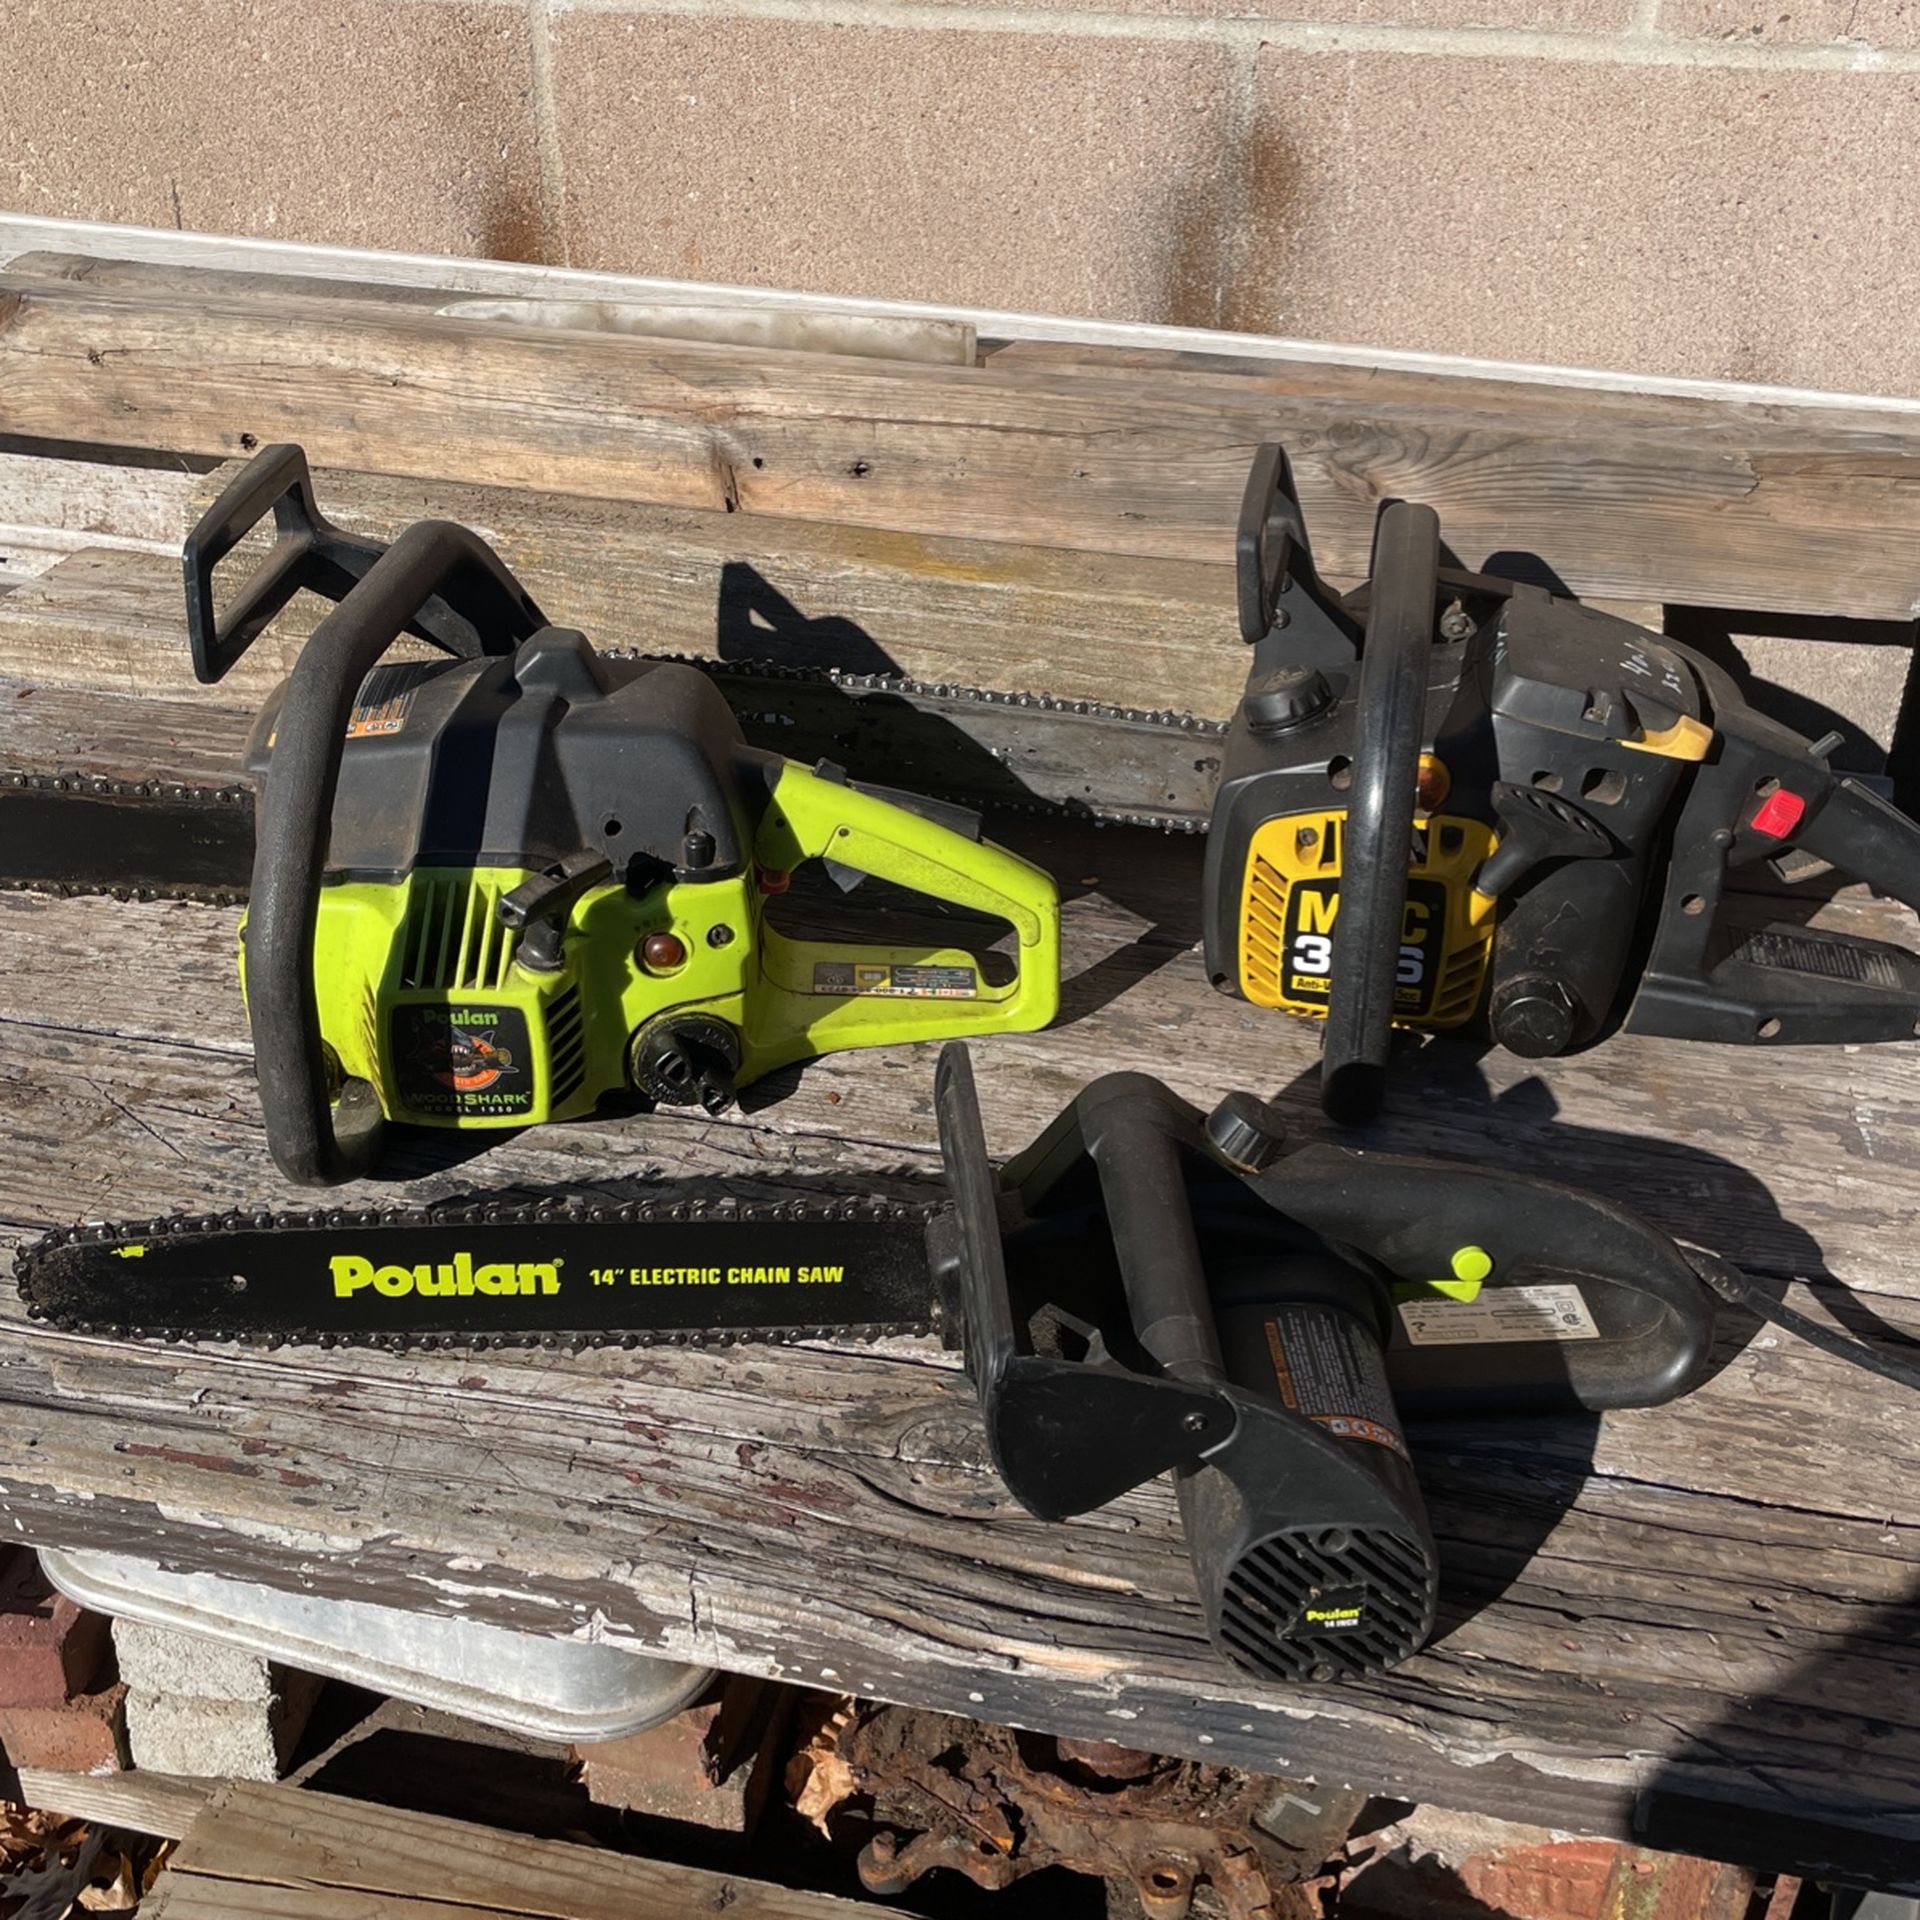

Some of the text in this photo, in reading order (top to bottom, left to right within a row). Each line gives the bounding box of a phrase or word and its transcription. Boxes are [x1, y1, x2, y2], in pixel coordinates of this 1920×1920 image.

[1297, 889, 1430, 944] MC
[1292, 934, 1424, 983] 36
[424, 1009, 498, 1025] Poulan
[330, 1252, 561, 1297] Poulan
[630, 1268, 721, 1285] ELECTRIC
[727, 1267, 790, 1284] CHAIN
[797, 1266, 844, 1283] SAW
[1306, 1608, 1359, 1621] Poulan
